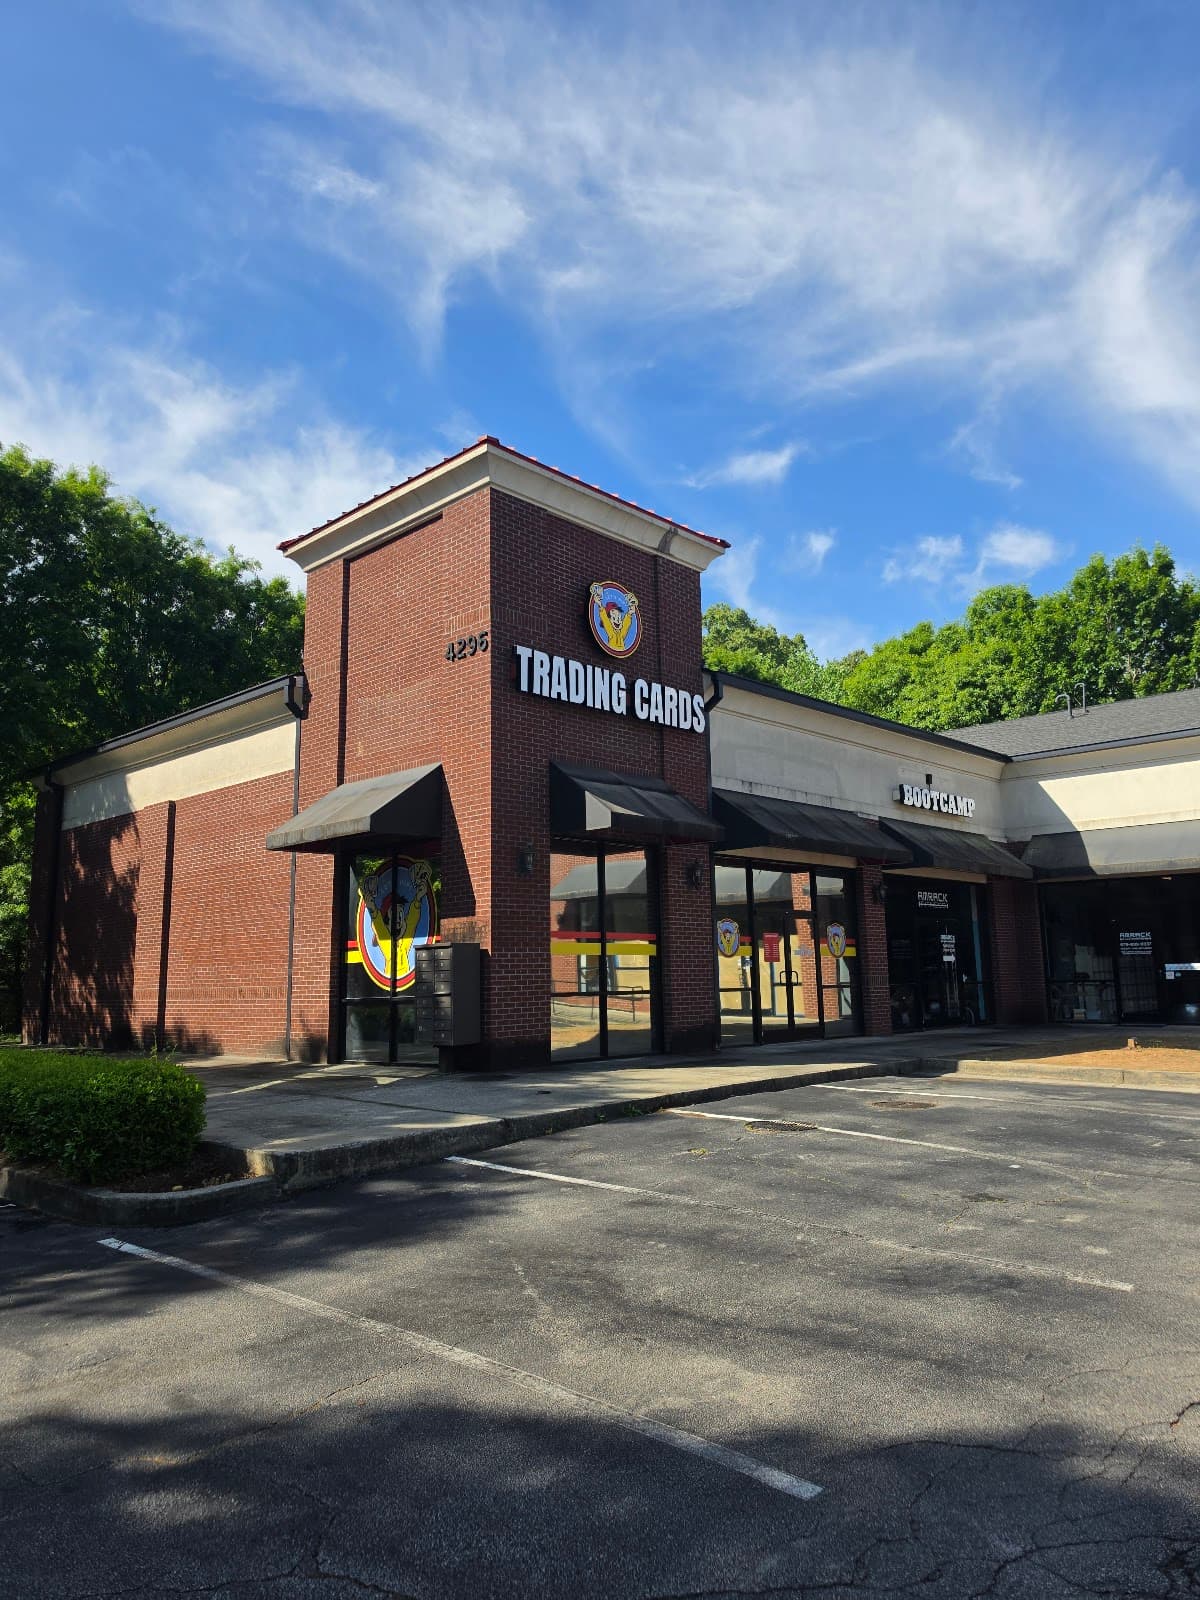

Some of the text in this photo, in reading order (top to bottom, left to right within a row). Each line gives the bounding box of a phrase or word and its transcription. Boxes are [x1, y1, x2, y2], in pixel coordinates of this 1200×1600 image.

[445, 631, 489, 662] 4296
[516, 645, 706, 734] TRADING CARDS
[902, 784, 976, 818] BOOTCAMP
